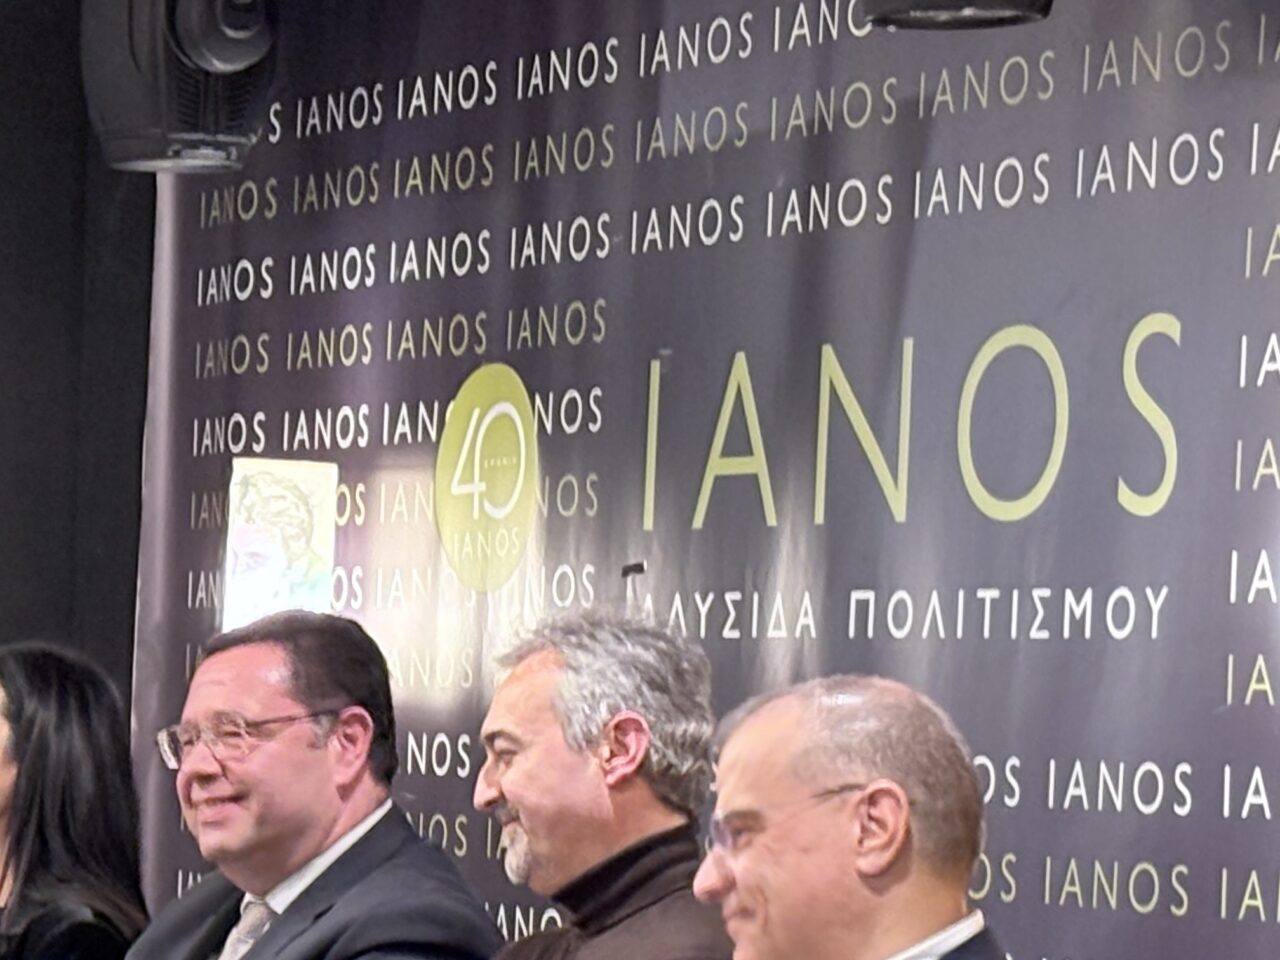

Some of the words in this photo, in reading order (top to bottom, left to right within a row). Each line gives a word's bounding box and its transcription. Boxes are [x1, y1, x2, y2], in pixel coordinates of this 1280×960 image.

[296, 83, 384, 138] IANOS
[397, 61, 498, 118] IANOS
[517, 38, 619, 99] IANOS
[639, 12, 754, 77] IANOS
[774, 0, 872, 52] IANO
[200, 177, 277, 229] IANOS
[293, 163, 380, 213] IANOS
[393, 144, 494, 197] IANOS
[514, 124, 615, 181] IANOS
[636, 103, 749, 163] IANOS
[770, 77, 897, 141] IANOS
[919, 50, 1055, 119] IANOS
[1083, 20, 1231, 94] IANOS
[197, 257, 274, 306] IANOS
[289, 243, 376, 295] IANOS
[390, 230, 491, 285] IANOS
[510, 213, 611, 270] IANOS
[631, 195, 744, 254] IANOS
[766, 175, 893, 237] IANOS
[914, 152, 1050, 219] IANOS
[1076, 128, 1225, 198] IANOS
[195, 333, 270, 379] IANOS
[287, 323, 373, 370] IANOS
[386, 312, 487, 361] IANOS
[506, 298, 607, 351] IANOS
[193, 411, 266, 457] IANOS
[283, 403, 369, 451] IANOS
[382, 398, 455, 446] IAN
[534, 386, 603, 436] NOS
[642, 312, 1181, 530] IANOS
[451, 401, 526, 521] 40
[379, 481, 435, 525] IAN
[452, 527, 520, 564] IANOS
[188, 570, 222, 609] IAN
[848, 586, 1169, 640] ΠΟΛΙΤΙΣΜΟΥ
[407, 731, 470, 778] NOS
[1048, 758, 1192, 817] IANOS
[1044, 855, 1188, 917] IANOS
